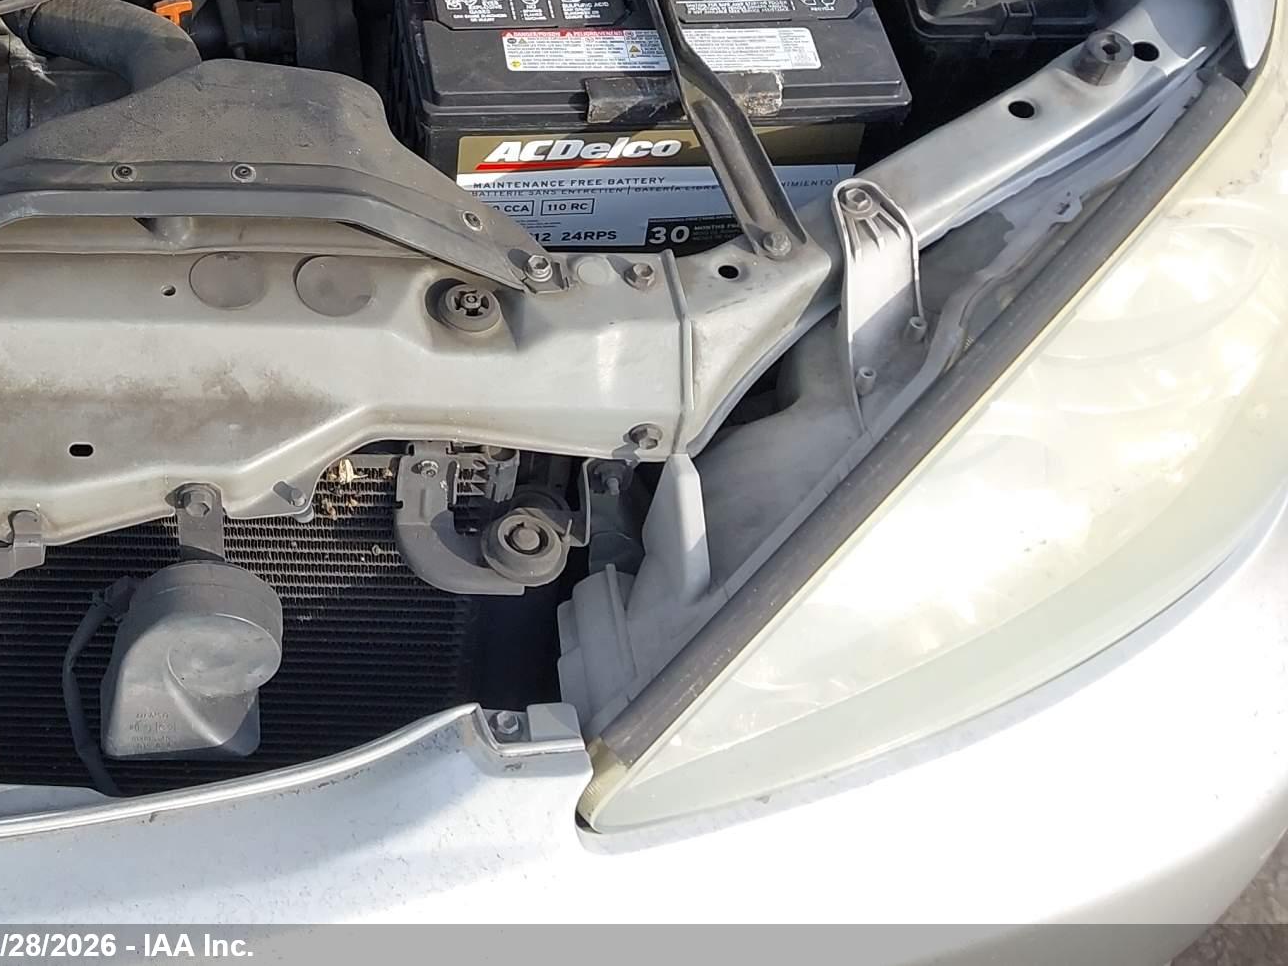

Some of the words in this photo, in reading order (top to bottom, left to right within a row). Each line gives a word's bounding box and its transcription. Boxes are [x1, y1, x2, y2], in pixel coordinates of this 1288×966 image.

[484, 136, 682, 163] ACDelco
[473, 179, 565, 189] MAINTENANCE
[570, 178, 603, 187] FREE
[607, 177, 666, 185] BATTERY
[548, 203, 567, 211] 110
[571, 202, 589, 210] RC
[534, 233, 552, 242] 12
[561, 230, 617, 242] 24RPS
[648, 224, 690, 245] 30
